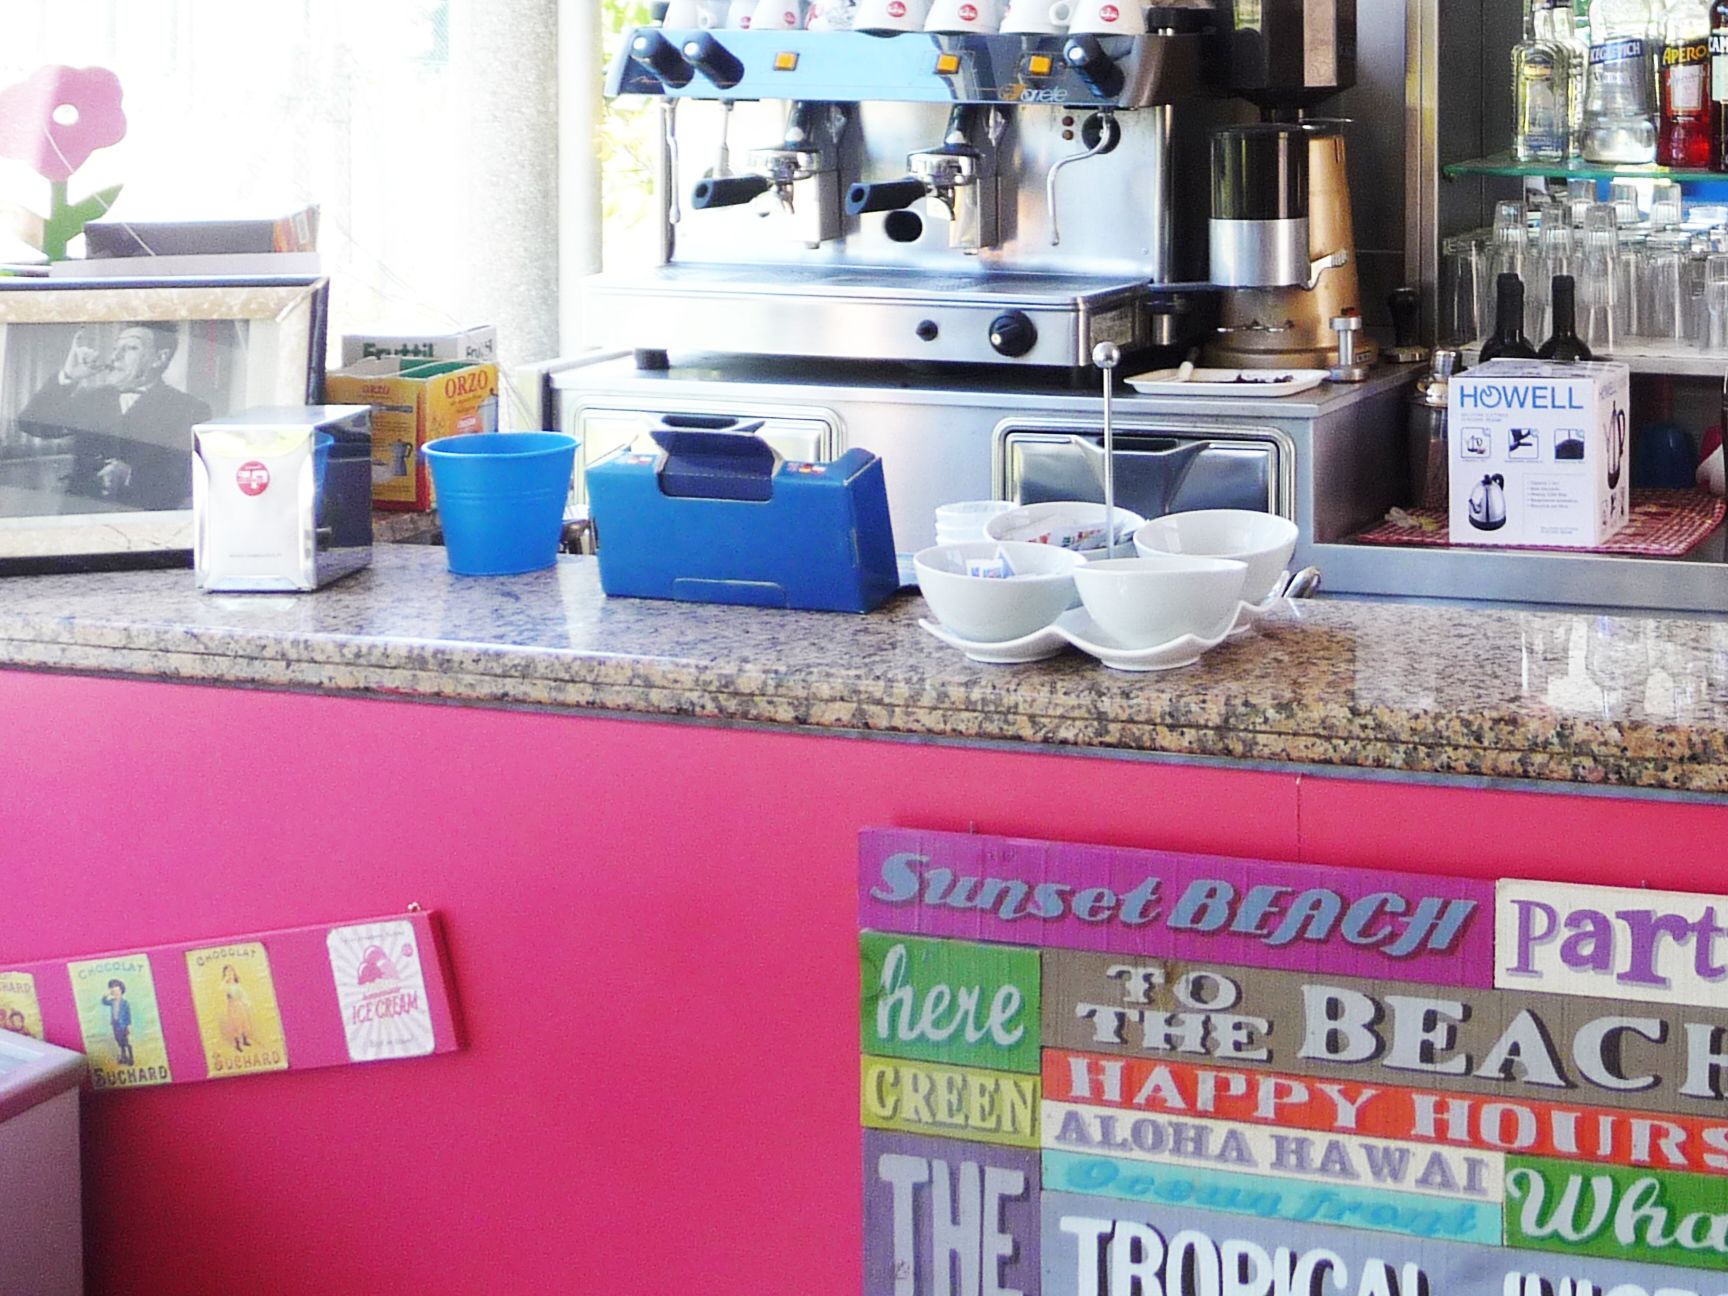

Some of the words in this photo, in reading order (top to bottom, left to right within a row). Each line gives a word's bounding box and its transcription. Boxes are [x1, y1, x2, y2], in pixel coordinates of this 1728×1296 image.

[1662, 44, 1708, 64] APERO
[443, 368, 489, 400] ORZO
[1460, 385, 1584, 409] HOWELL
[870, 852, 1164, 926] Sunset
[1166, 879, 1478, 960] BEACH
[78, 961, 145, 980] CHOCOLAT
[196, 947, 257, 967] CHOCOLAT
[875, 943, 1026, 1047] here
[1106, 963, 1243, 1011] TO
[352, 1002, 373, 1025] ICE
[375, 990, 419, 1019] CREAM
[1075, 1002, 1274, 1063] THE
[94, 1065, 169, 1089] SUCHARD
[212, 1050, 281, 1072] SUCHARD
[1066, 1056, 1384, 1132] HAPPY
[1053, 1109, 1260, 1168] ALOHA
[1269, 1132, 1490, 1197] HAWAI
[877, 1153, 1030, 1296] THE
